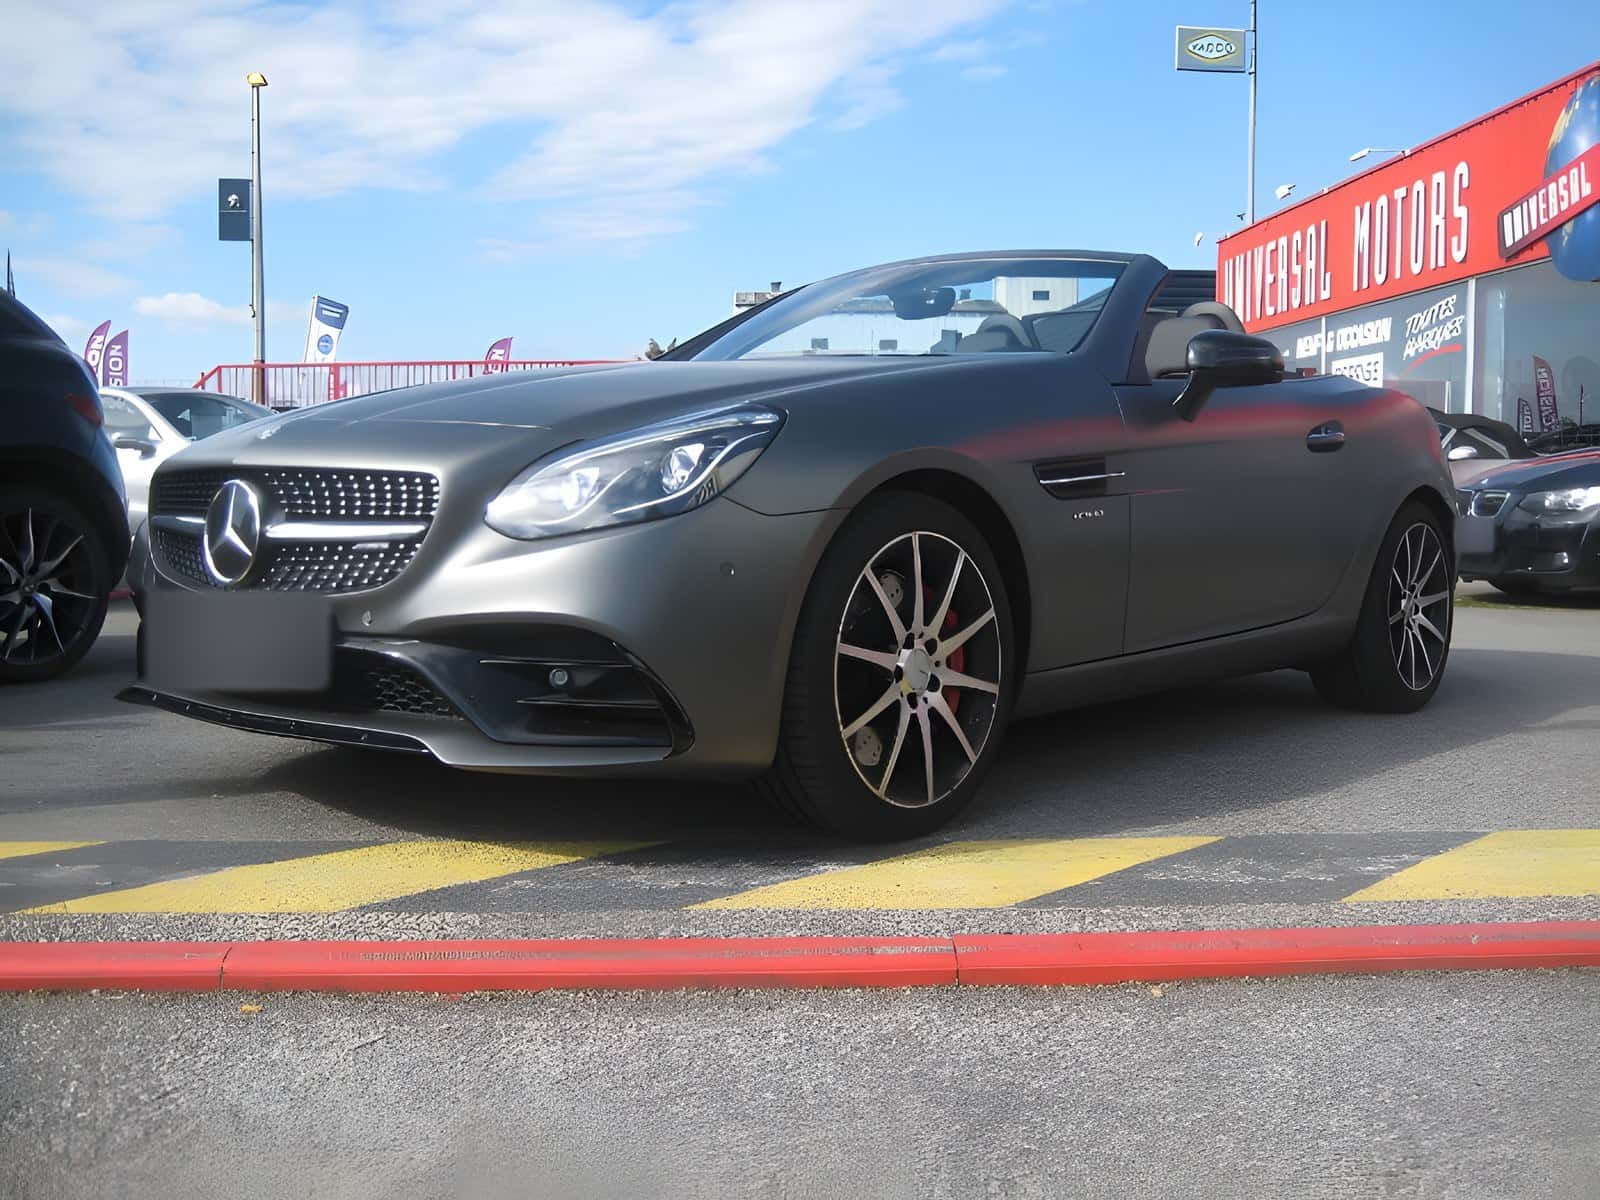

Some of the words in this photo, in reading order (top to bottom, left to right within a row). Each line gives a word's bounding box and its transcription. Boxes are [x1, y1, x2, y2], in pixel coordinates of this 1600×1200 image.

[1224, 219, 1331, 323] UNIVERSAL
[1352, 161, 1470, 292] MOTORS
[1503, 161, 1592, 248] UNIVERSAL
[1405, 294, 1457, 338] TOUTES
